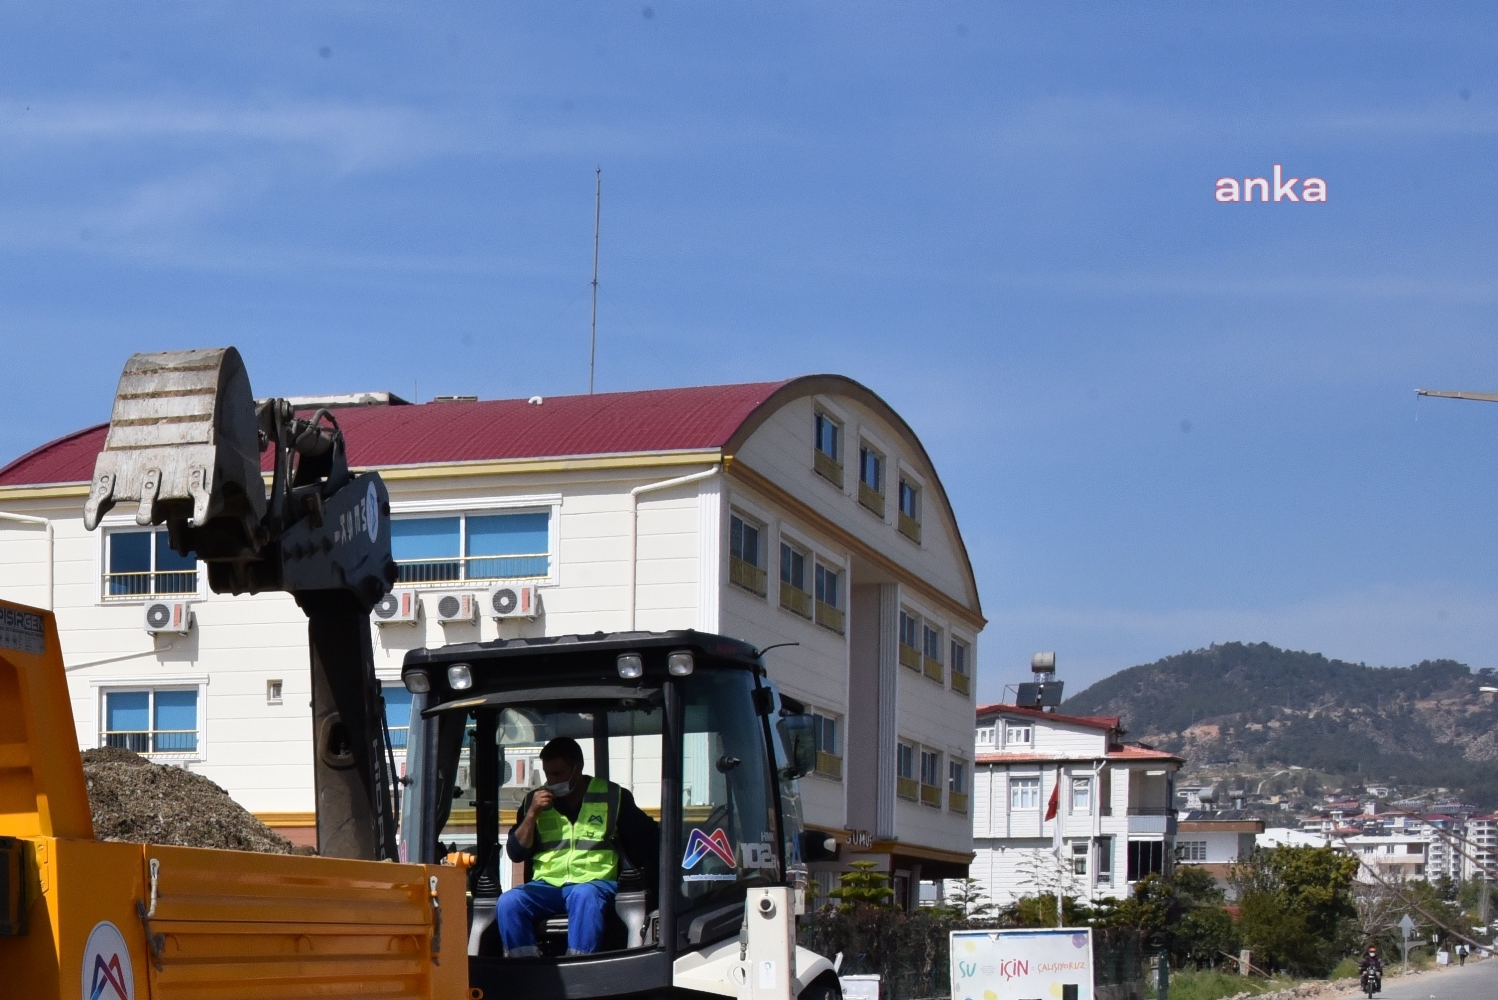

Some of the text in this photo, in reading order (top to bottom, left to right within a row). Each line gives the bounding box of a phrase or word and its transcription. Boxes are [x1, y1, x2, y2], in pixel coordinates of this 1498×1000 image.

[959, 961, 977, 978] SU
[1000, 959, 1029, 981] İÇİN
[1038, 962, 1085, 974] ÇALIŞIYORUZ
